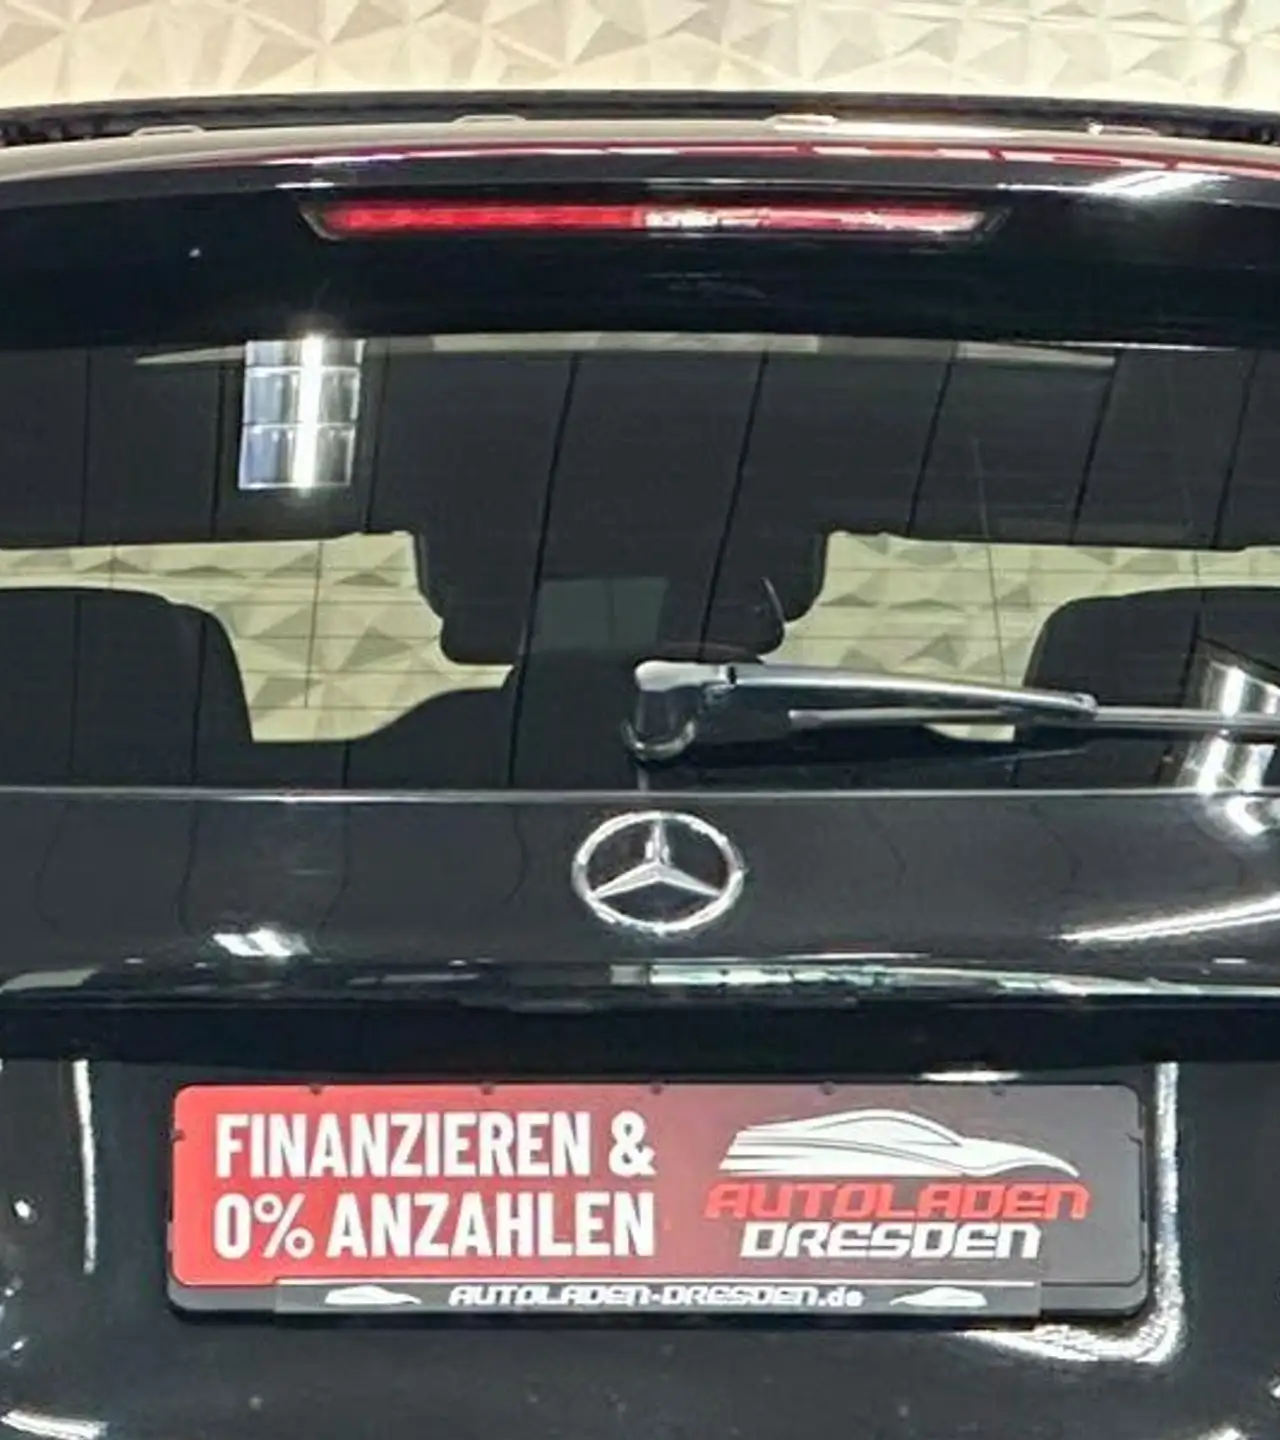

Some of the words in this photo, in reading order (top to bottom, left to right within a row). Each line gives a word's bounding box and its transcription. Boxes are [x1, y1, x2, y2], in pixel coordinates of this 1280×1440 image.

[215, 1112, 593, 1178] FINANZIEREN
[609, 1111, 656, 1178] &
[706, 1181, 1090, 1219] AUTOLADEN
[213, 1194, 313, 1260] 0%
[328, 1191, 655, 1258] ANZAHLEN
[740, 1221, 1041, 1260] DRESDEN
[447, 1284, 863, 1308] AUTOLADEN-DRESDEN.de
